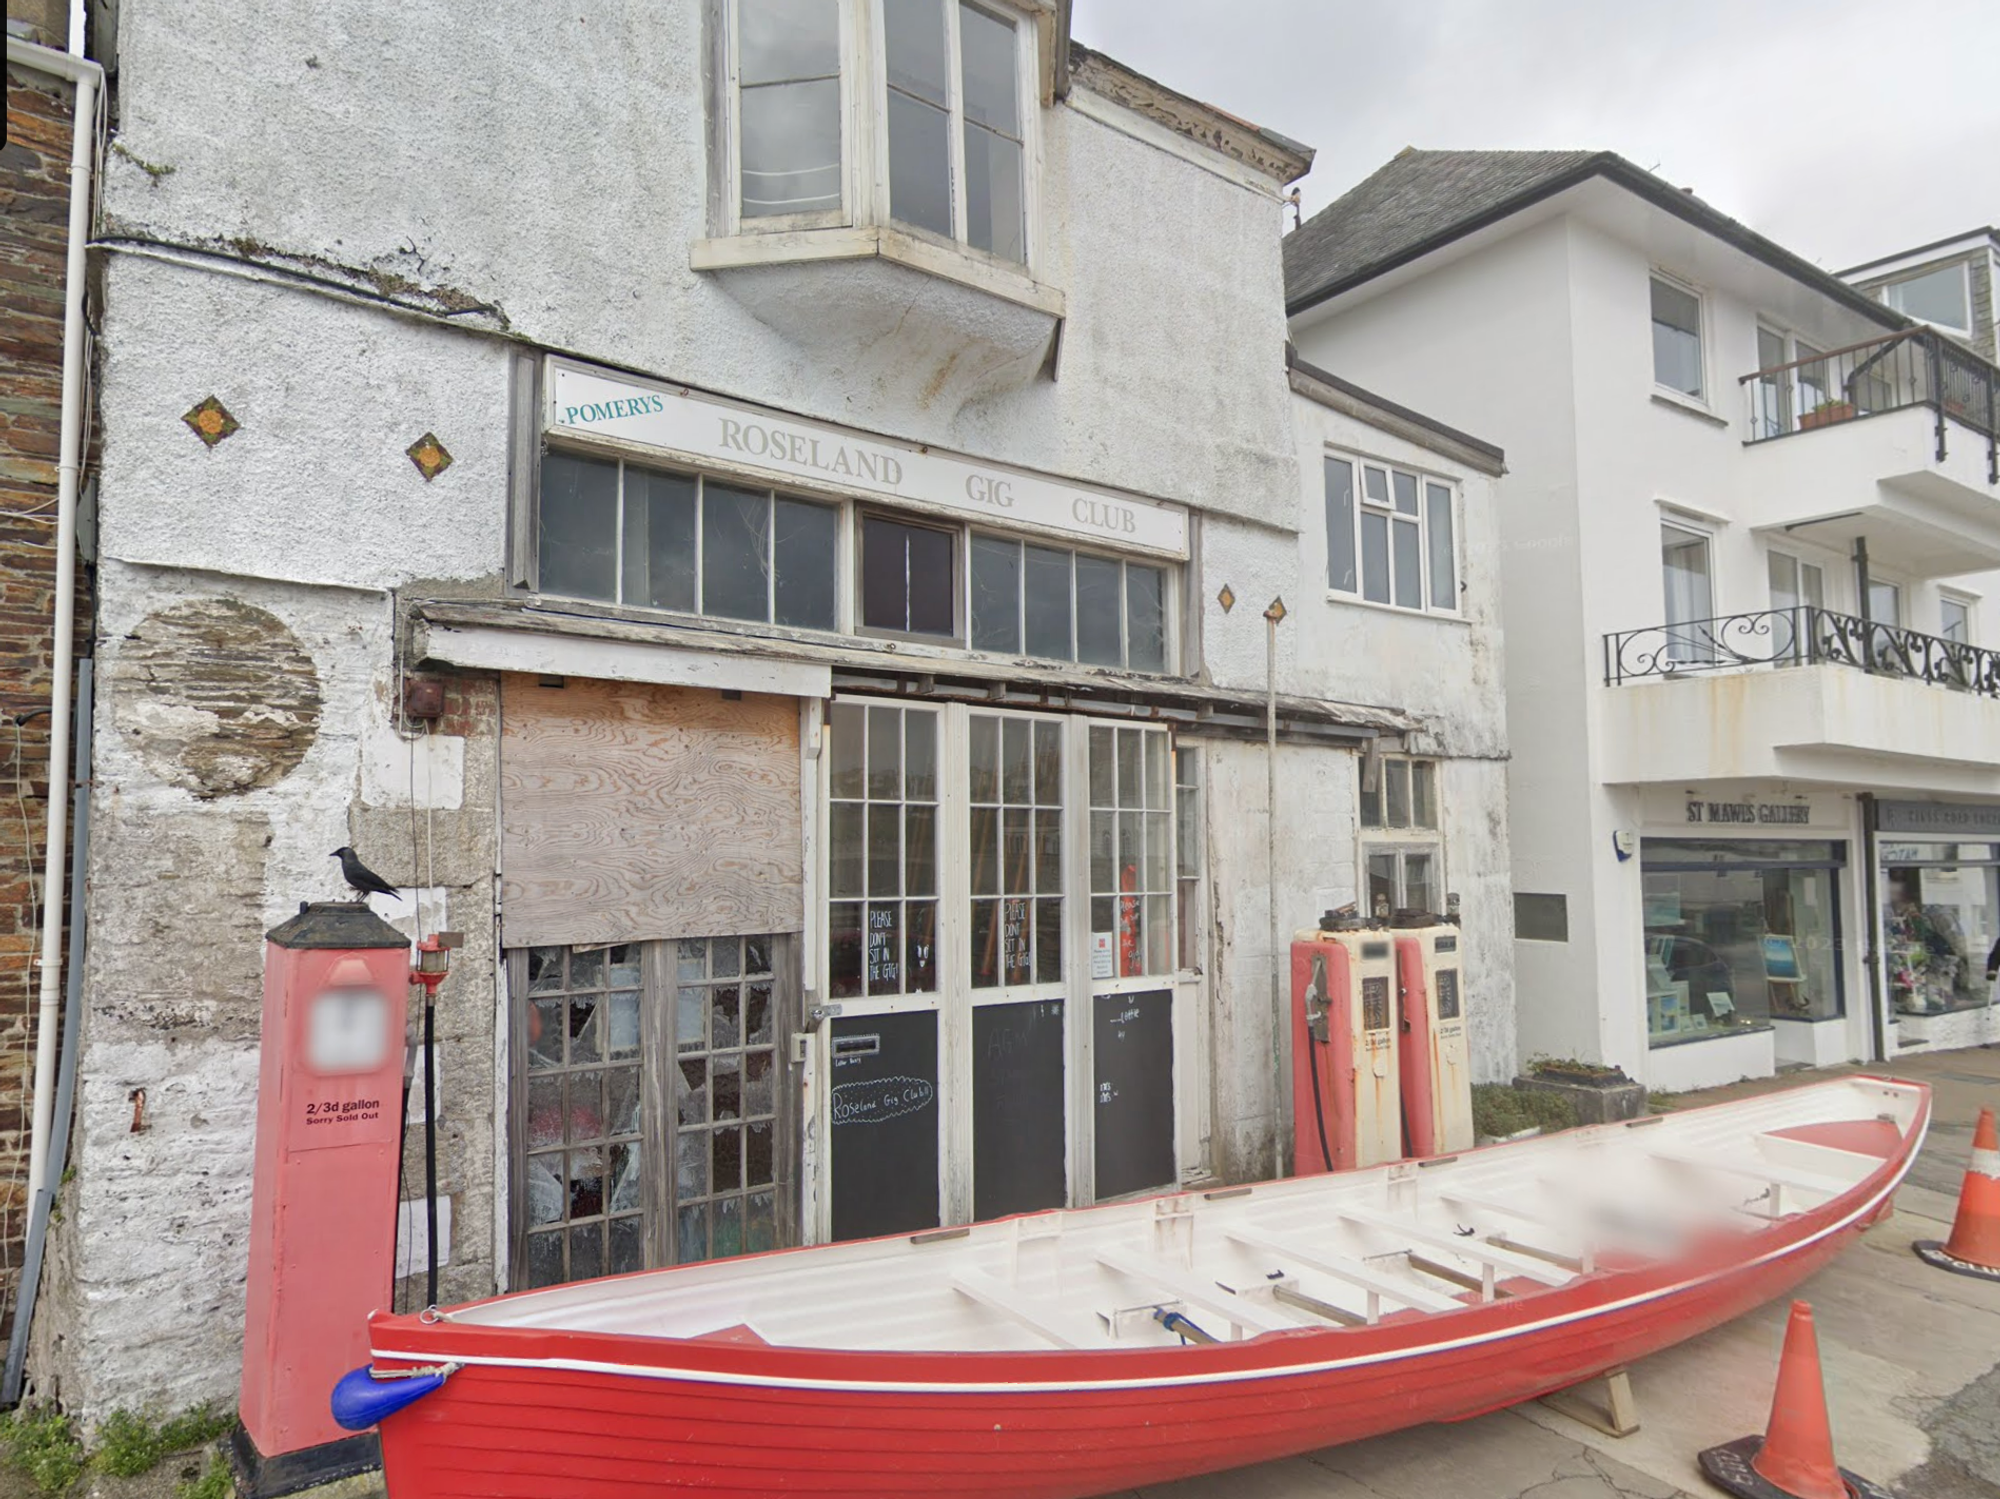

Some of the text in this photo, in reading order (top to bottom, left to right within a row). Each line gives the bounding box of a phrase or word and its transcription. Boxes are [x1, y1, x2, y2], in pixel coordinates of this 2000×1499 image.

[565, 394, 664, 425] POMERYS
[718, 418, 1136, 534] ROSELAND GIG CLUB
[870, 910, 892, 929] PLEASE
[883, 947, 890, 962] IN
[306, 1099, 380, 1115] 2/3d gallon
[832, 1092, 877, 1119] Roseland
[883, 1094, 899, 1106] Gig
[306, 1112, 379, 1125] Sorry Sold Out
